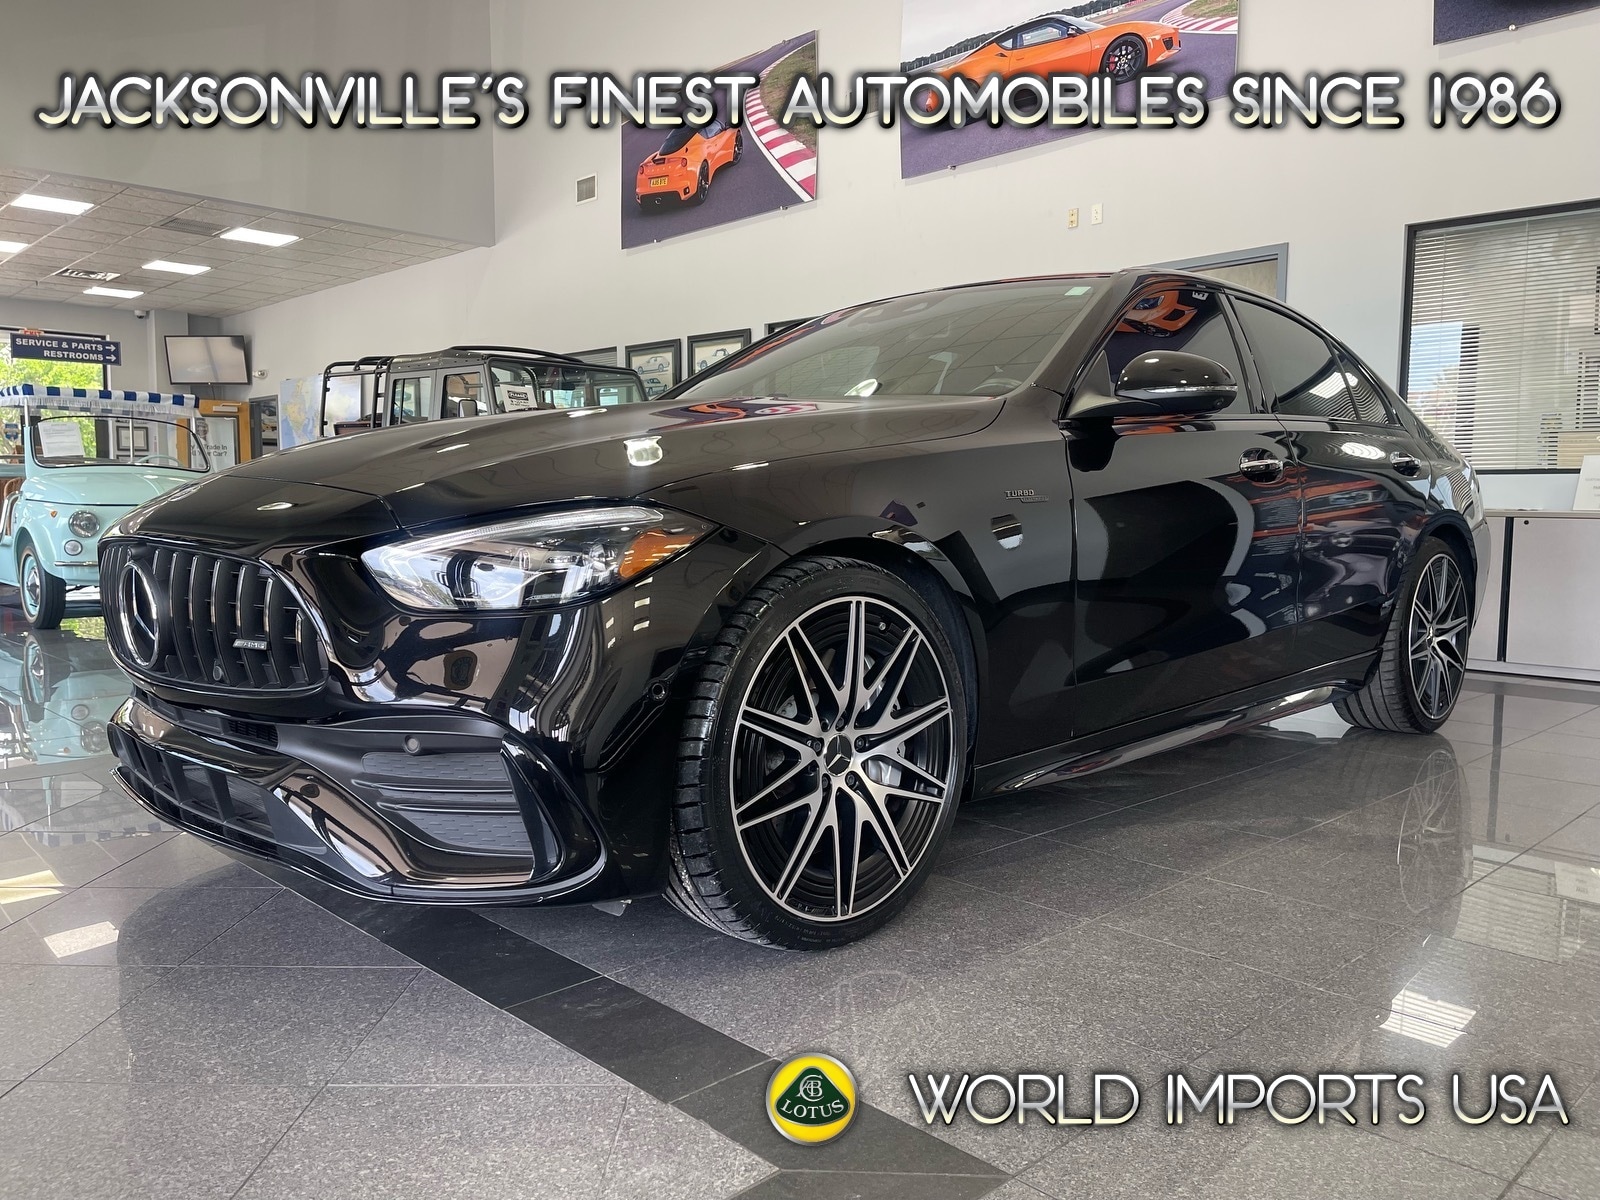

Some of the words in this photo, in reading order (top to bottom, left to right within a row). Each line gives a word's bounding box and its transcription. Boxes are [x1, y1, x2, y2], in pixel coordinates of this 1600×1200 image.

[15, 337, 59, 348] SERVICE
[71, 342, 103, 351] PARTS
[43, 350, 104, 361] RESTROOMS
[1004, 489, 1035, 497] TURBO
